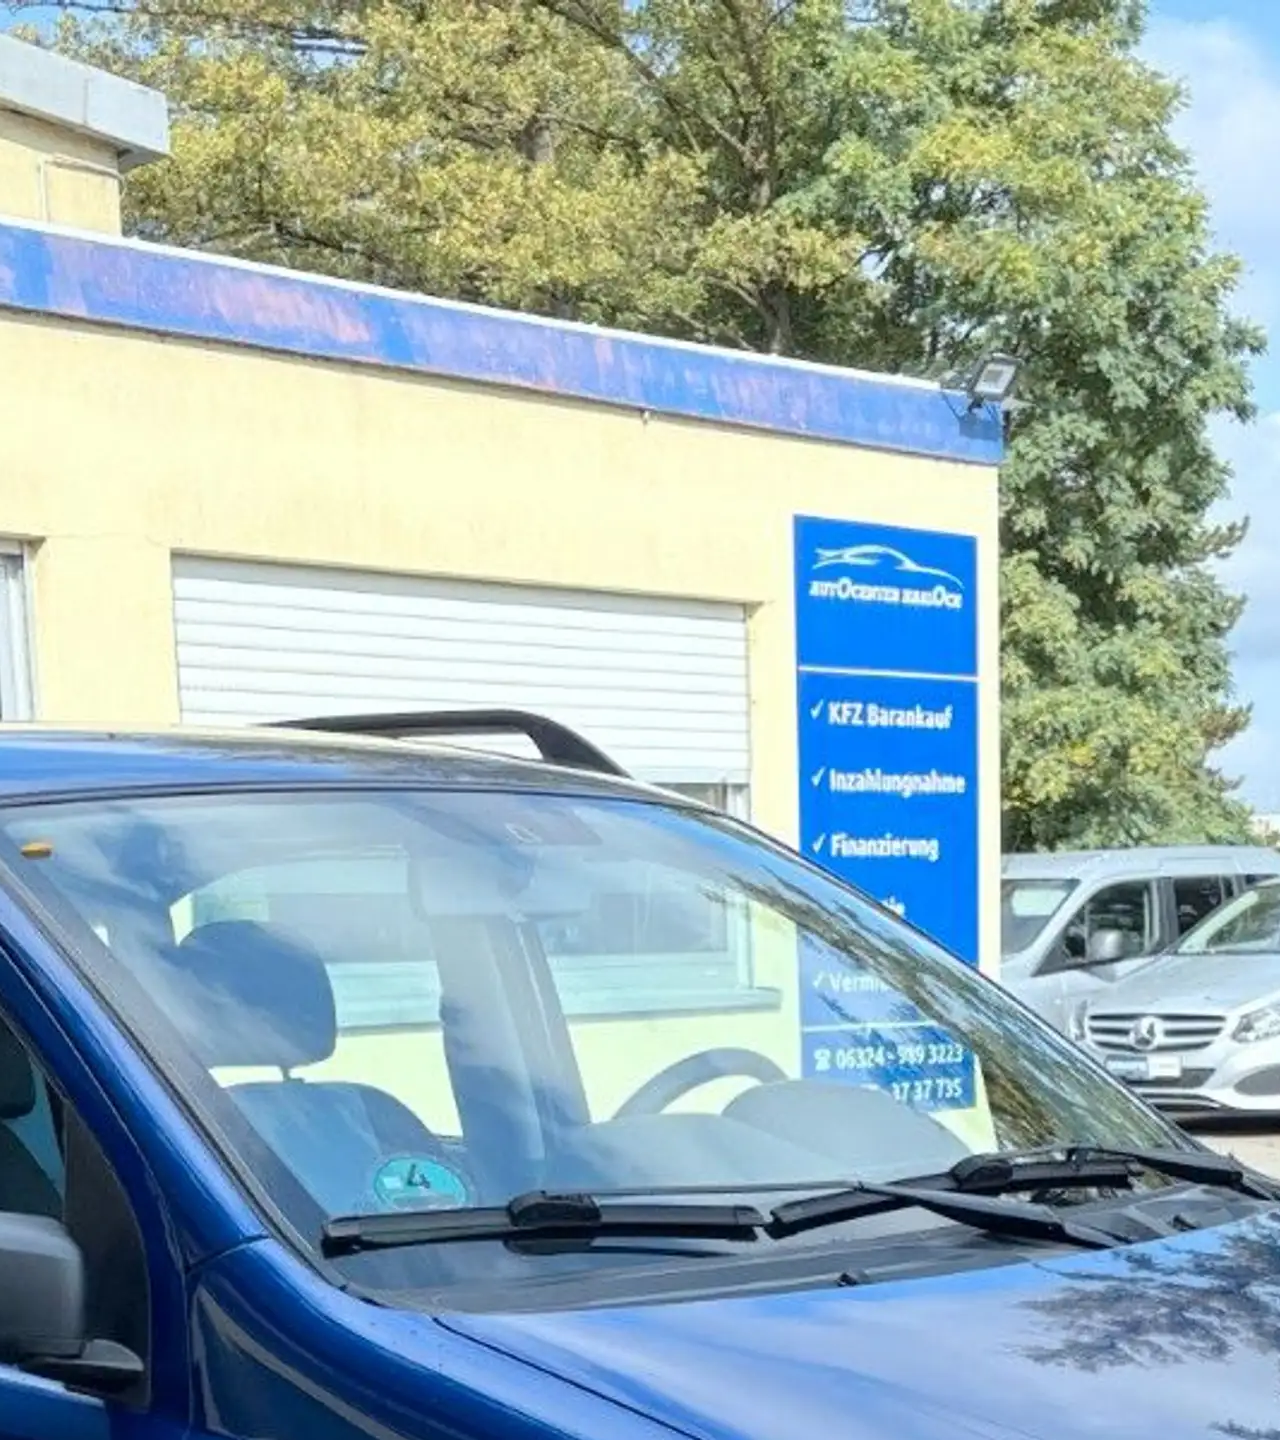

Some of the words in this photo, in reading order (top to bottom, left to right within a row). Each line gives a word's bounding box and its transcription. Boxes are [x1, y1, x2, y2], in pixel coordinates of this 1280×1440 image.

[827, 702, 862, 726] KFZ
[867, 703, 953, 729] Barankauf
[829, 769, 966, 798] Inzahlungnahme
[830, 832, 940, 861] Finanzierung
[836, 1046, 885, 1070] 06324
